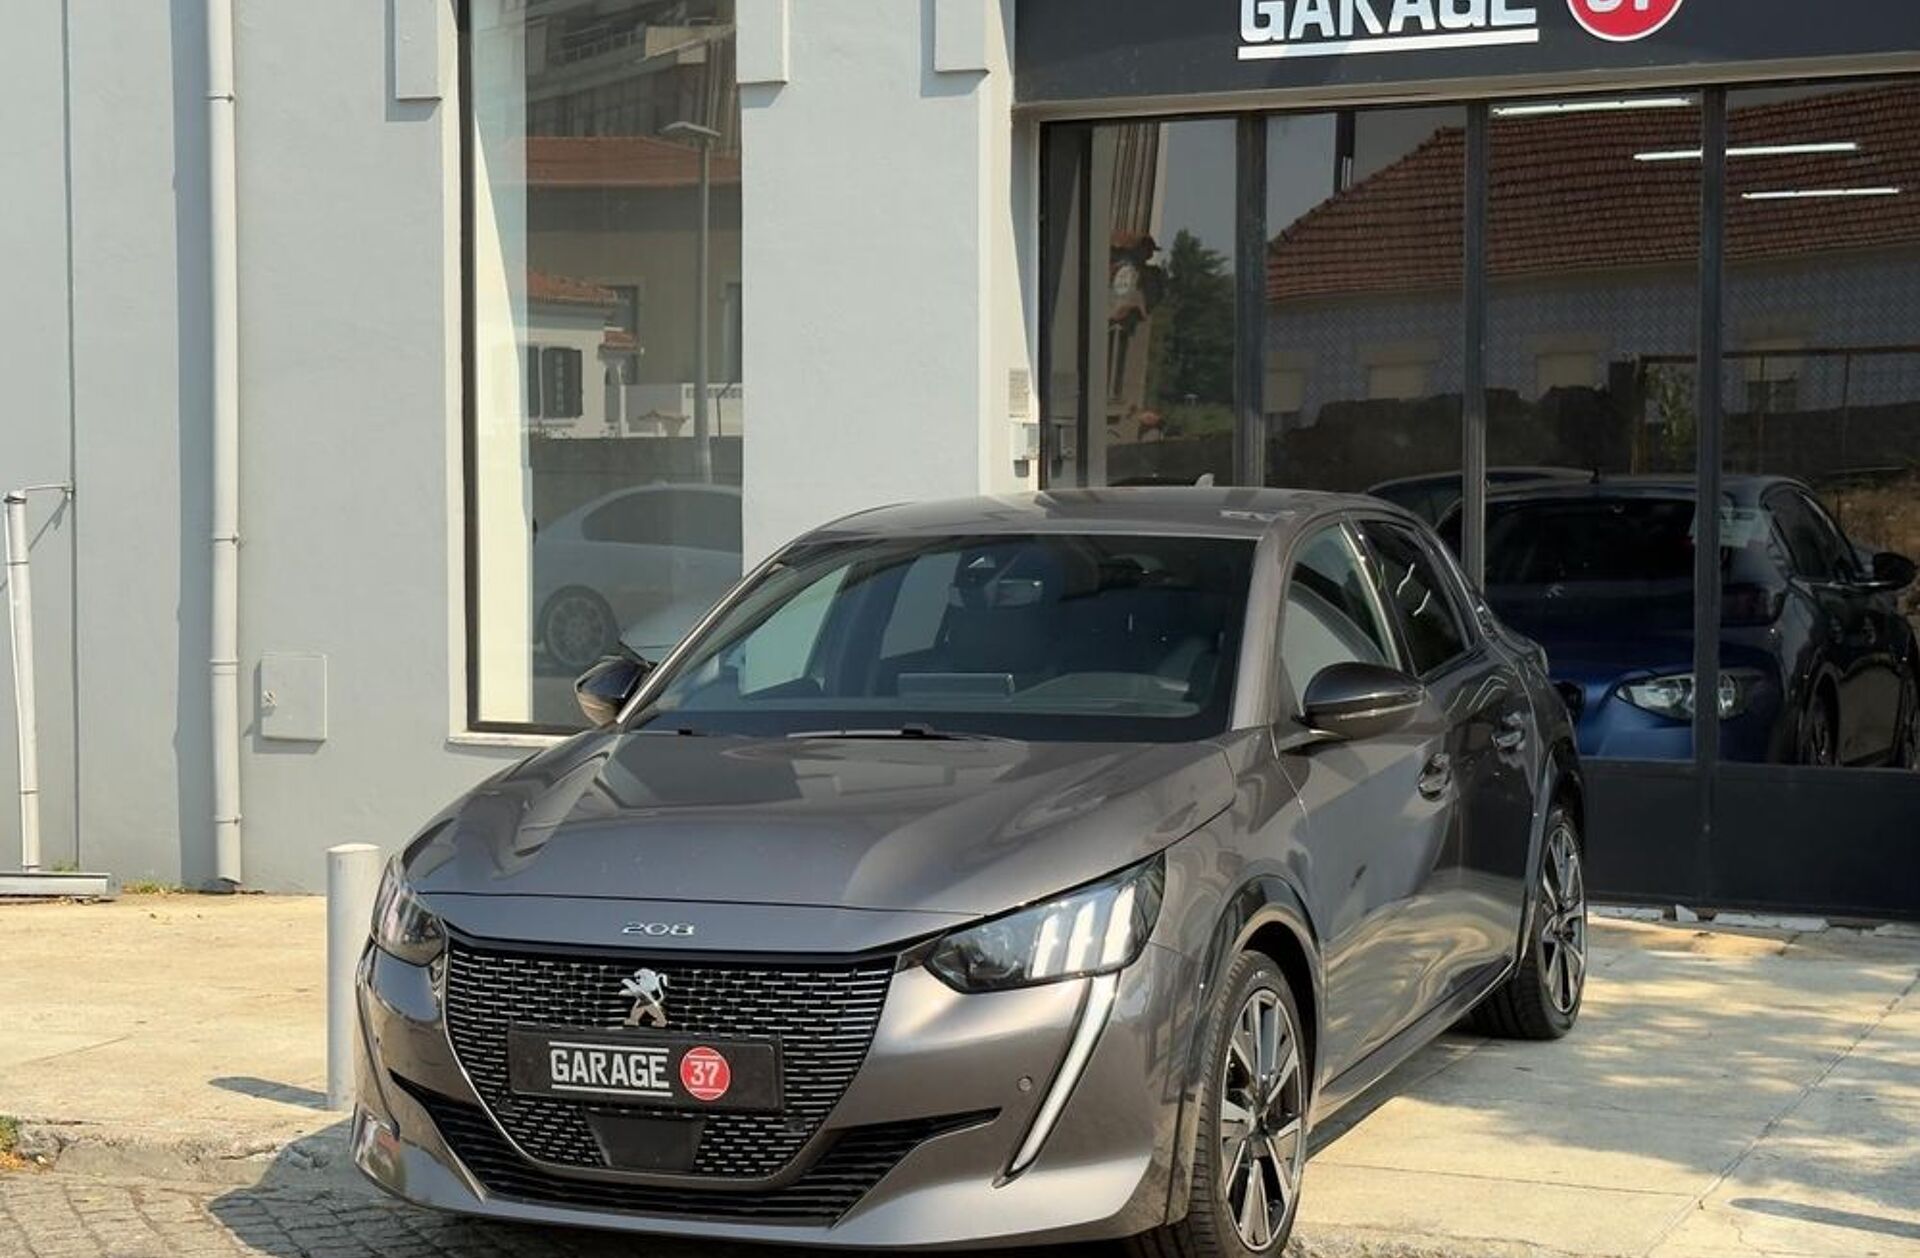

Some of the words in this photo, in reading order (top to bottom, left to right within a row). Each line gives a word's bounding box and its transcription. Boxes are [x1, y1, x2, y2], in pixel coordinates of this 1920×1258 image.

[622, 922, 695, 936] 208
[550, 1049, 669, 1089] GARAGE
[690, 1061, 720, 1086] 37
